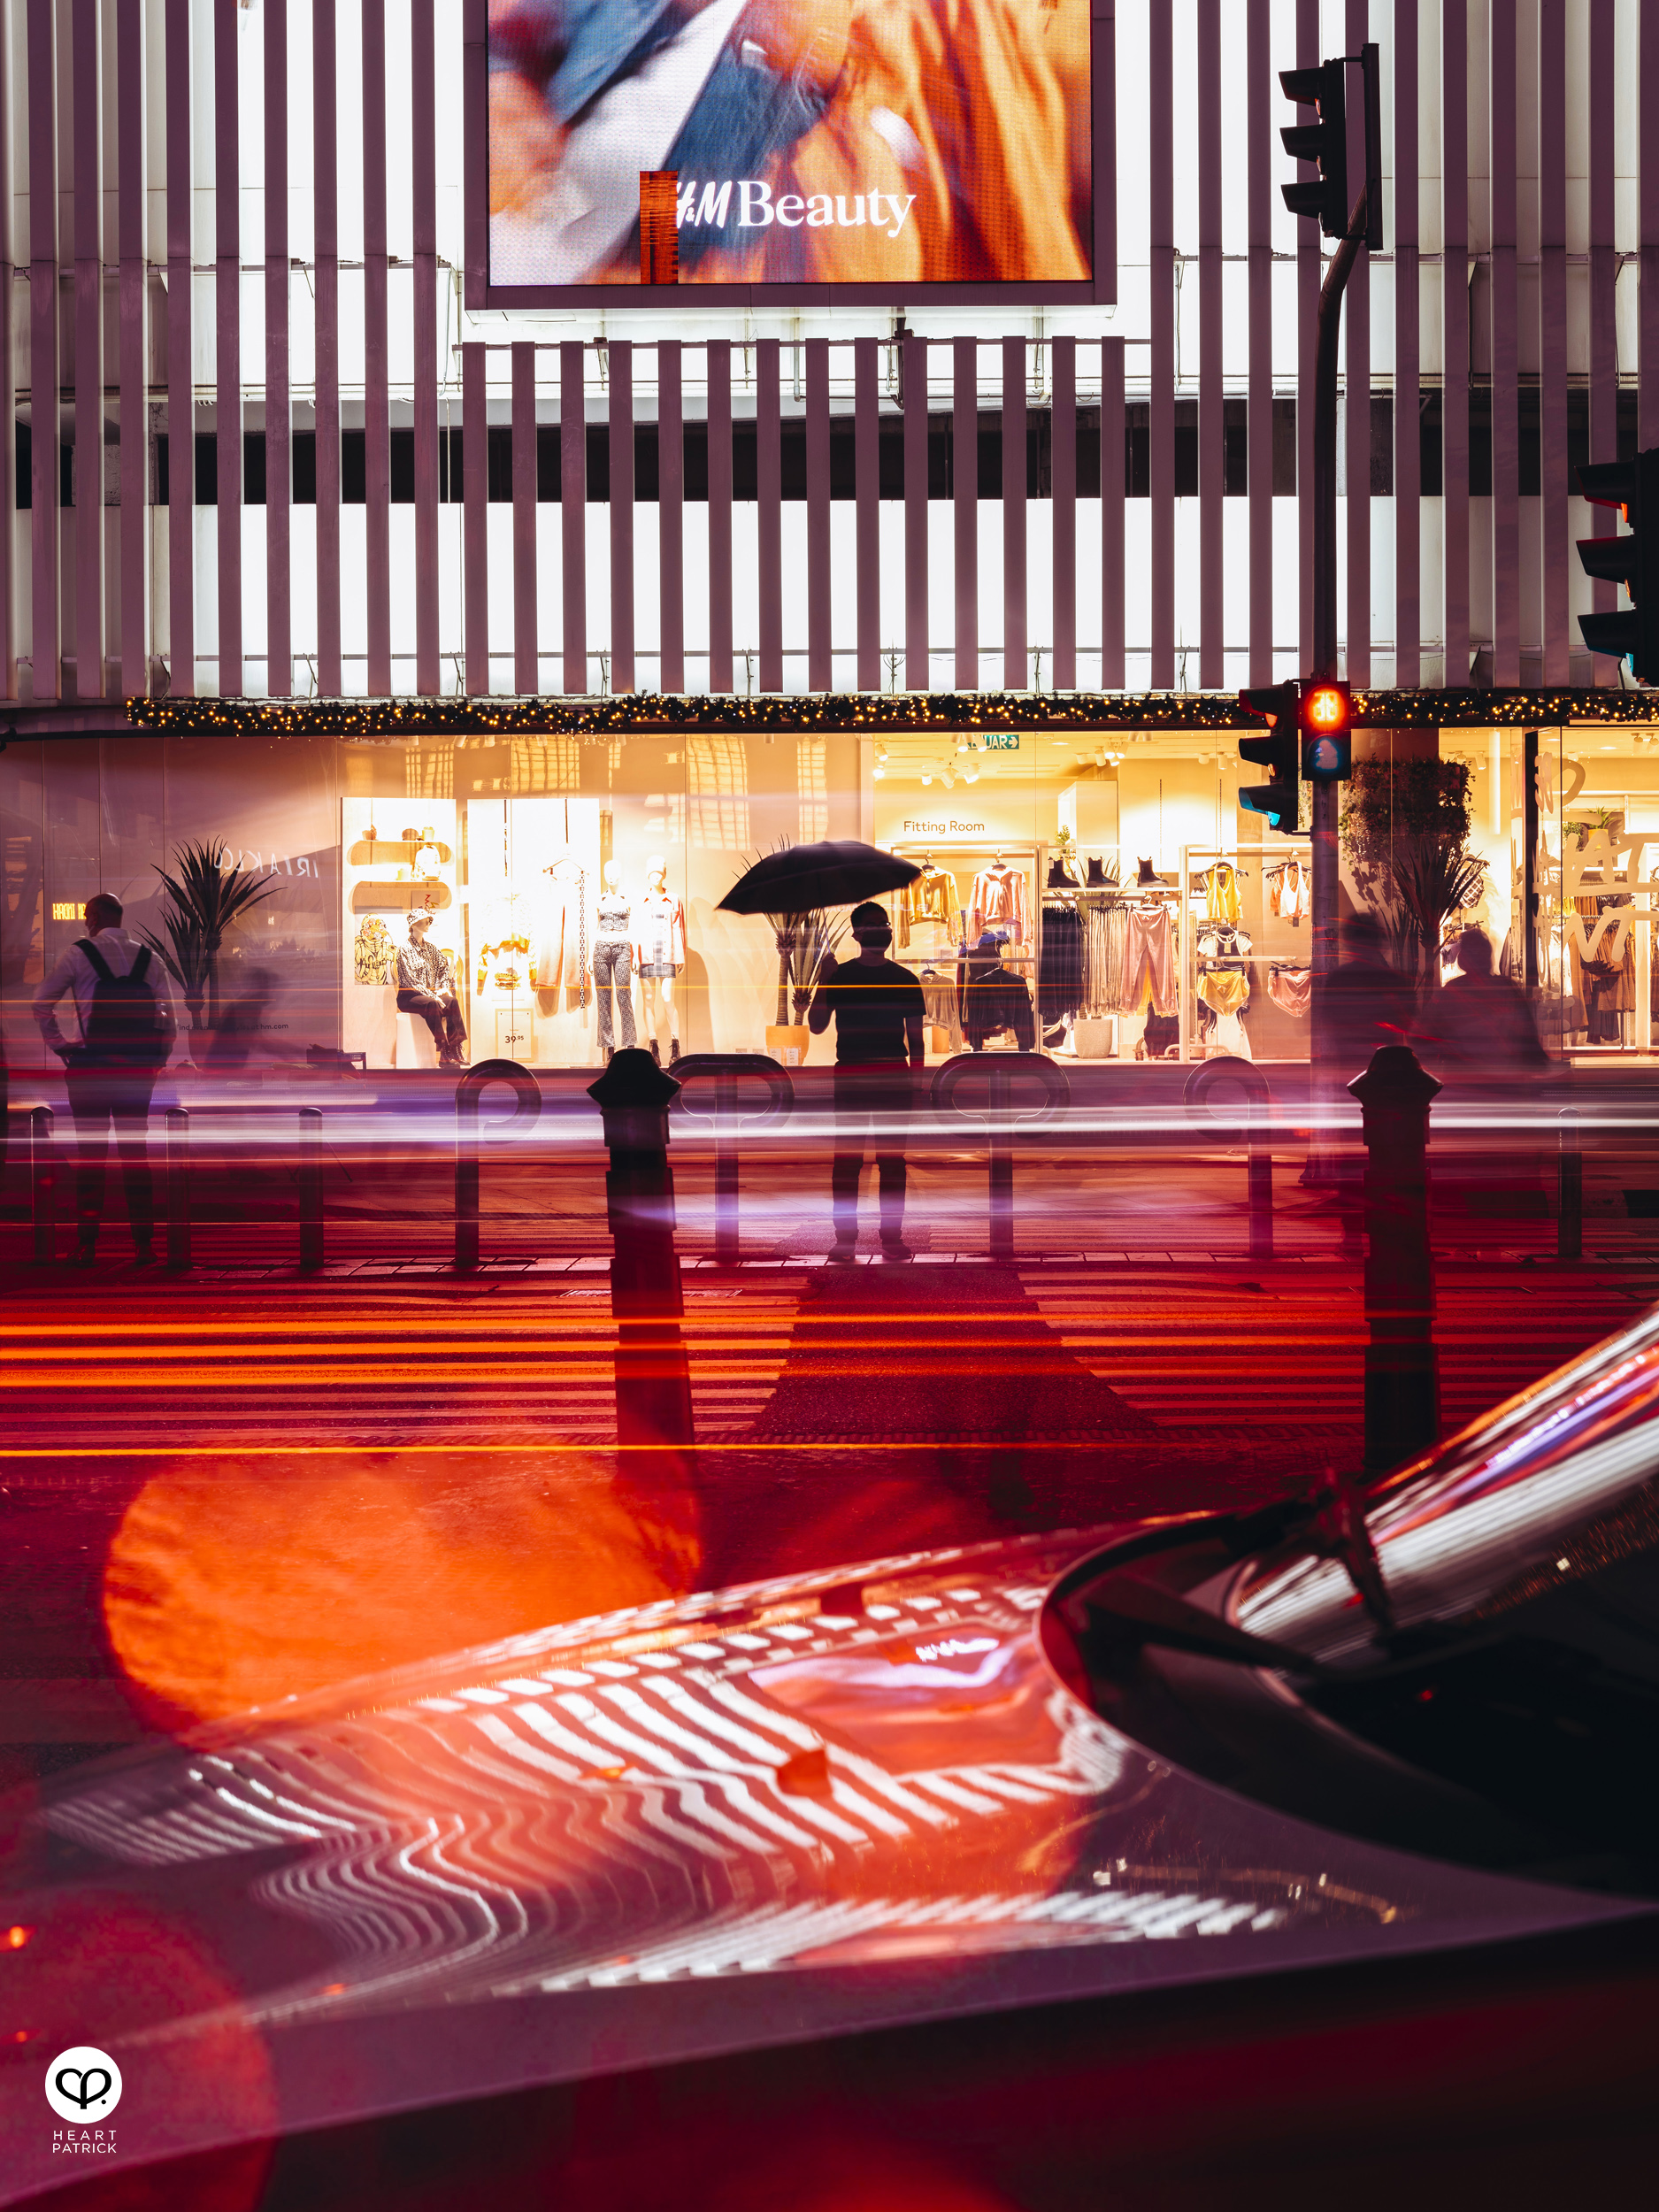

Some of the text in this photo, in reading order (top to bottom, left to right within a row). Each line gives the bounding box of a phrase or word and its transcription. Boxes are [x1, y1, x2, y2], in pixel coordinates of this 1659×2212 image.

[737, 180, 918, 238] Beauty
[903, 820, 985, 834] Fitting Room
[504, 1035, 525, 1044] 39.95
